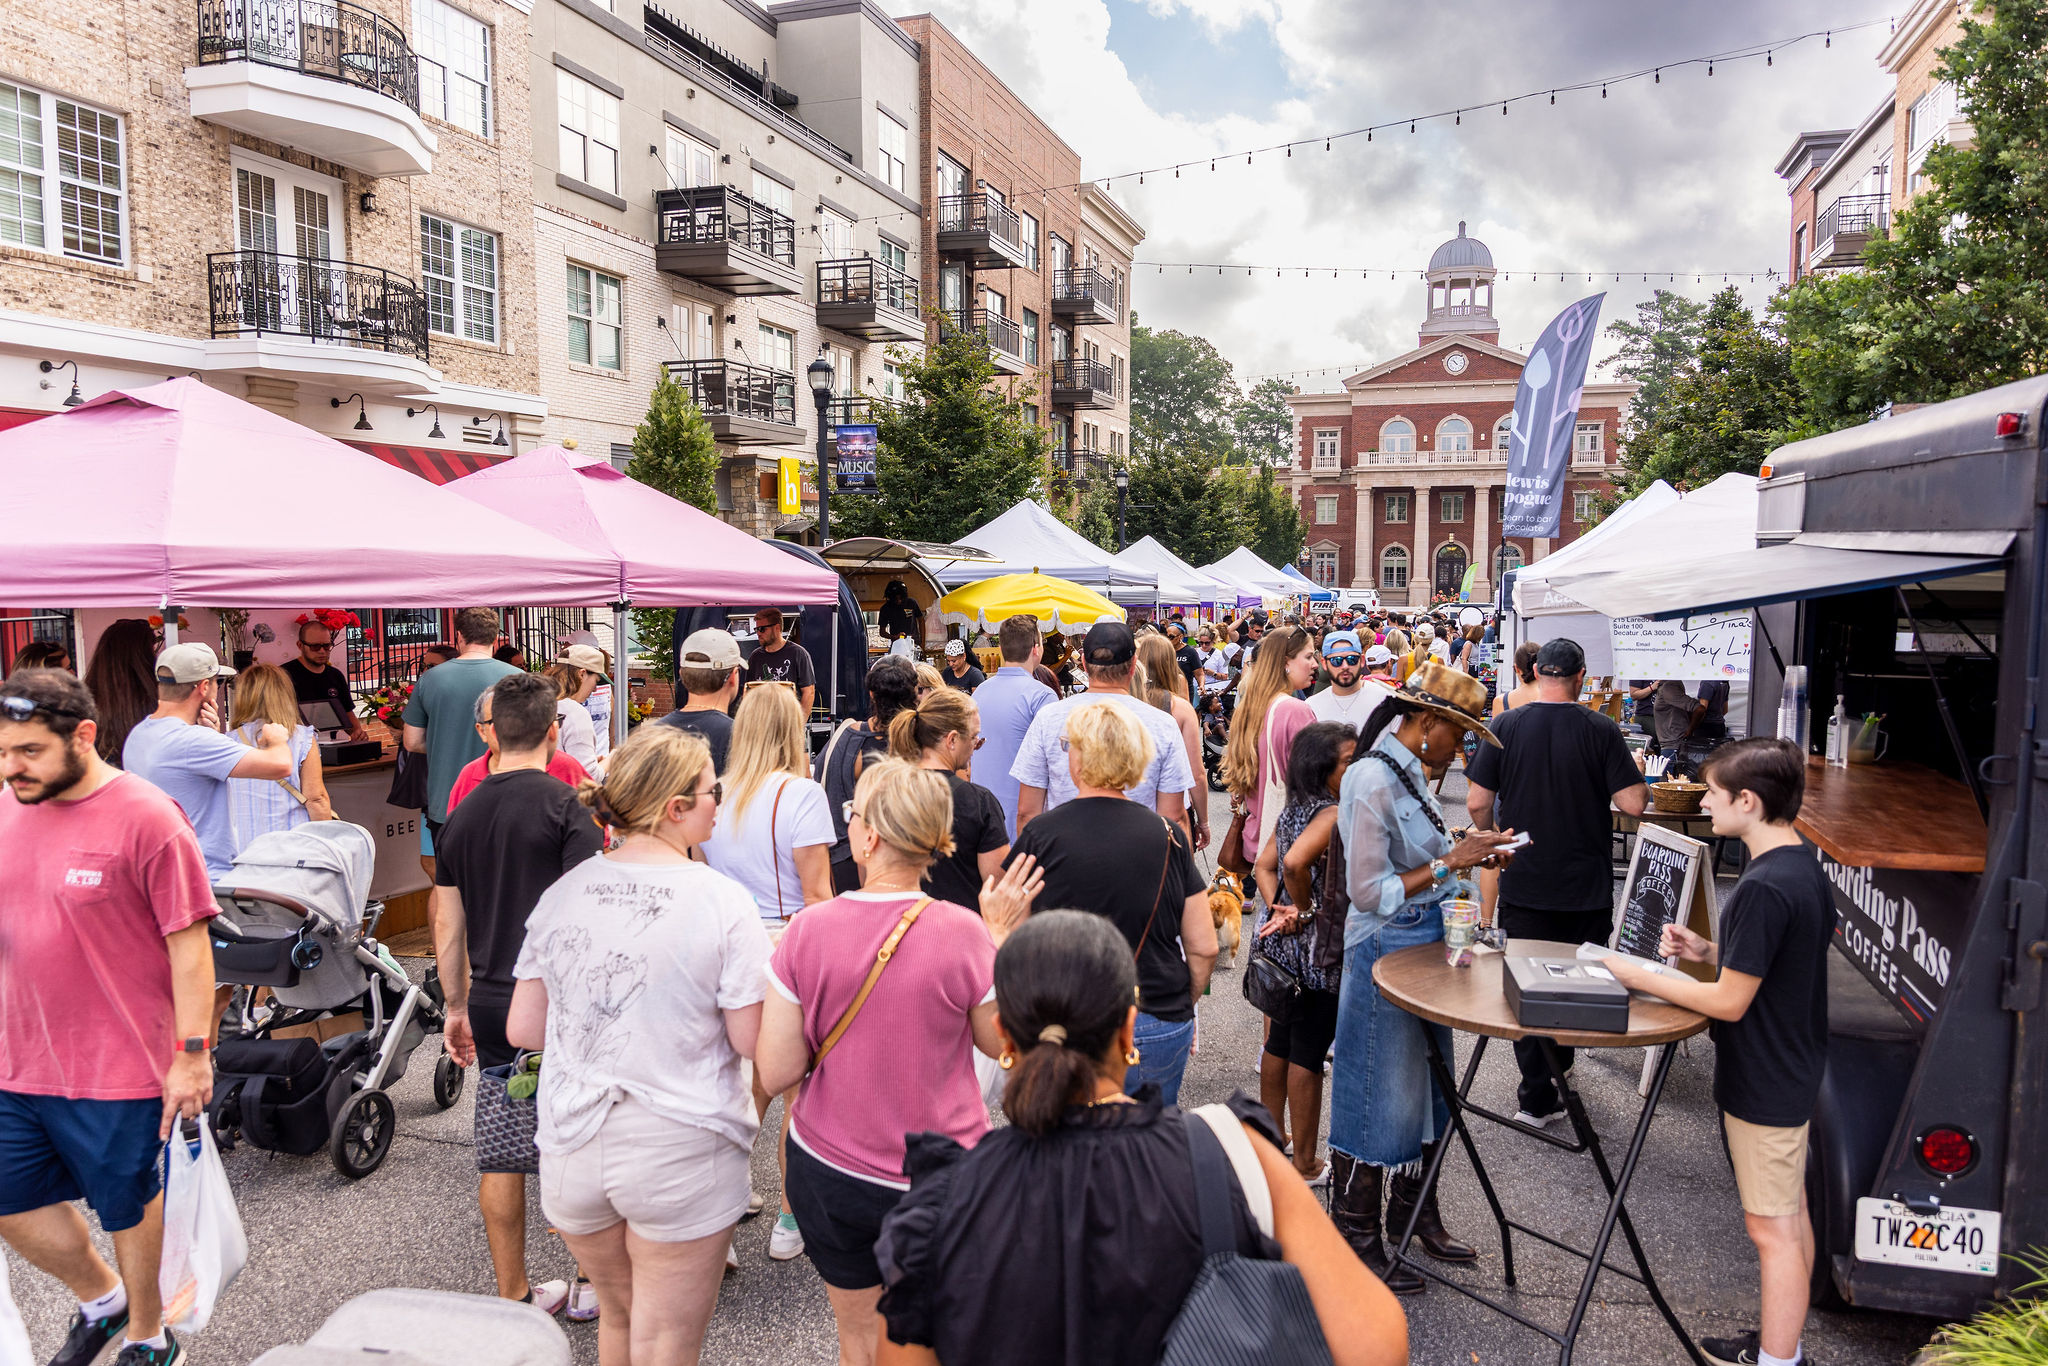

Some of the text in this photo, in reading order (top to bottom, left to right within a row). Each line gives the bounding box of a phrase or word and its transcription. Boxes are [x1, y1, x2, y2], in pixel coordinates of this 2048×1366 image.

[838, 461, 874, 473] MUSIC
[1506, 472, 1550, 489] lewis
[1503, 524, 1544, 532] hocolate
[1526, 514, 1536, 522] to
[1537, 514, 1553, 523] bar
[1682, 632, 1721, 666] Key
[386, 819, 415, 838] BEE
[1641, 841, 1690, 873] BOARDING
[1648, 860, 1673, 883] PASS
[1641, 879, 1673, 899] COFFEE
[1900, 895, 1951, 988] Pass
[1845, 920, 1899, 995] COFFEE
[1872, 1216, 1984, 1256] TW22C40
